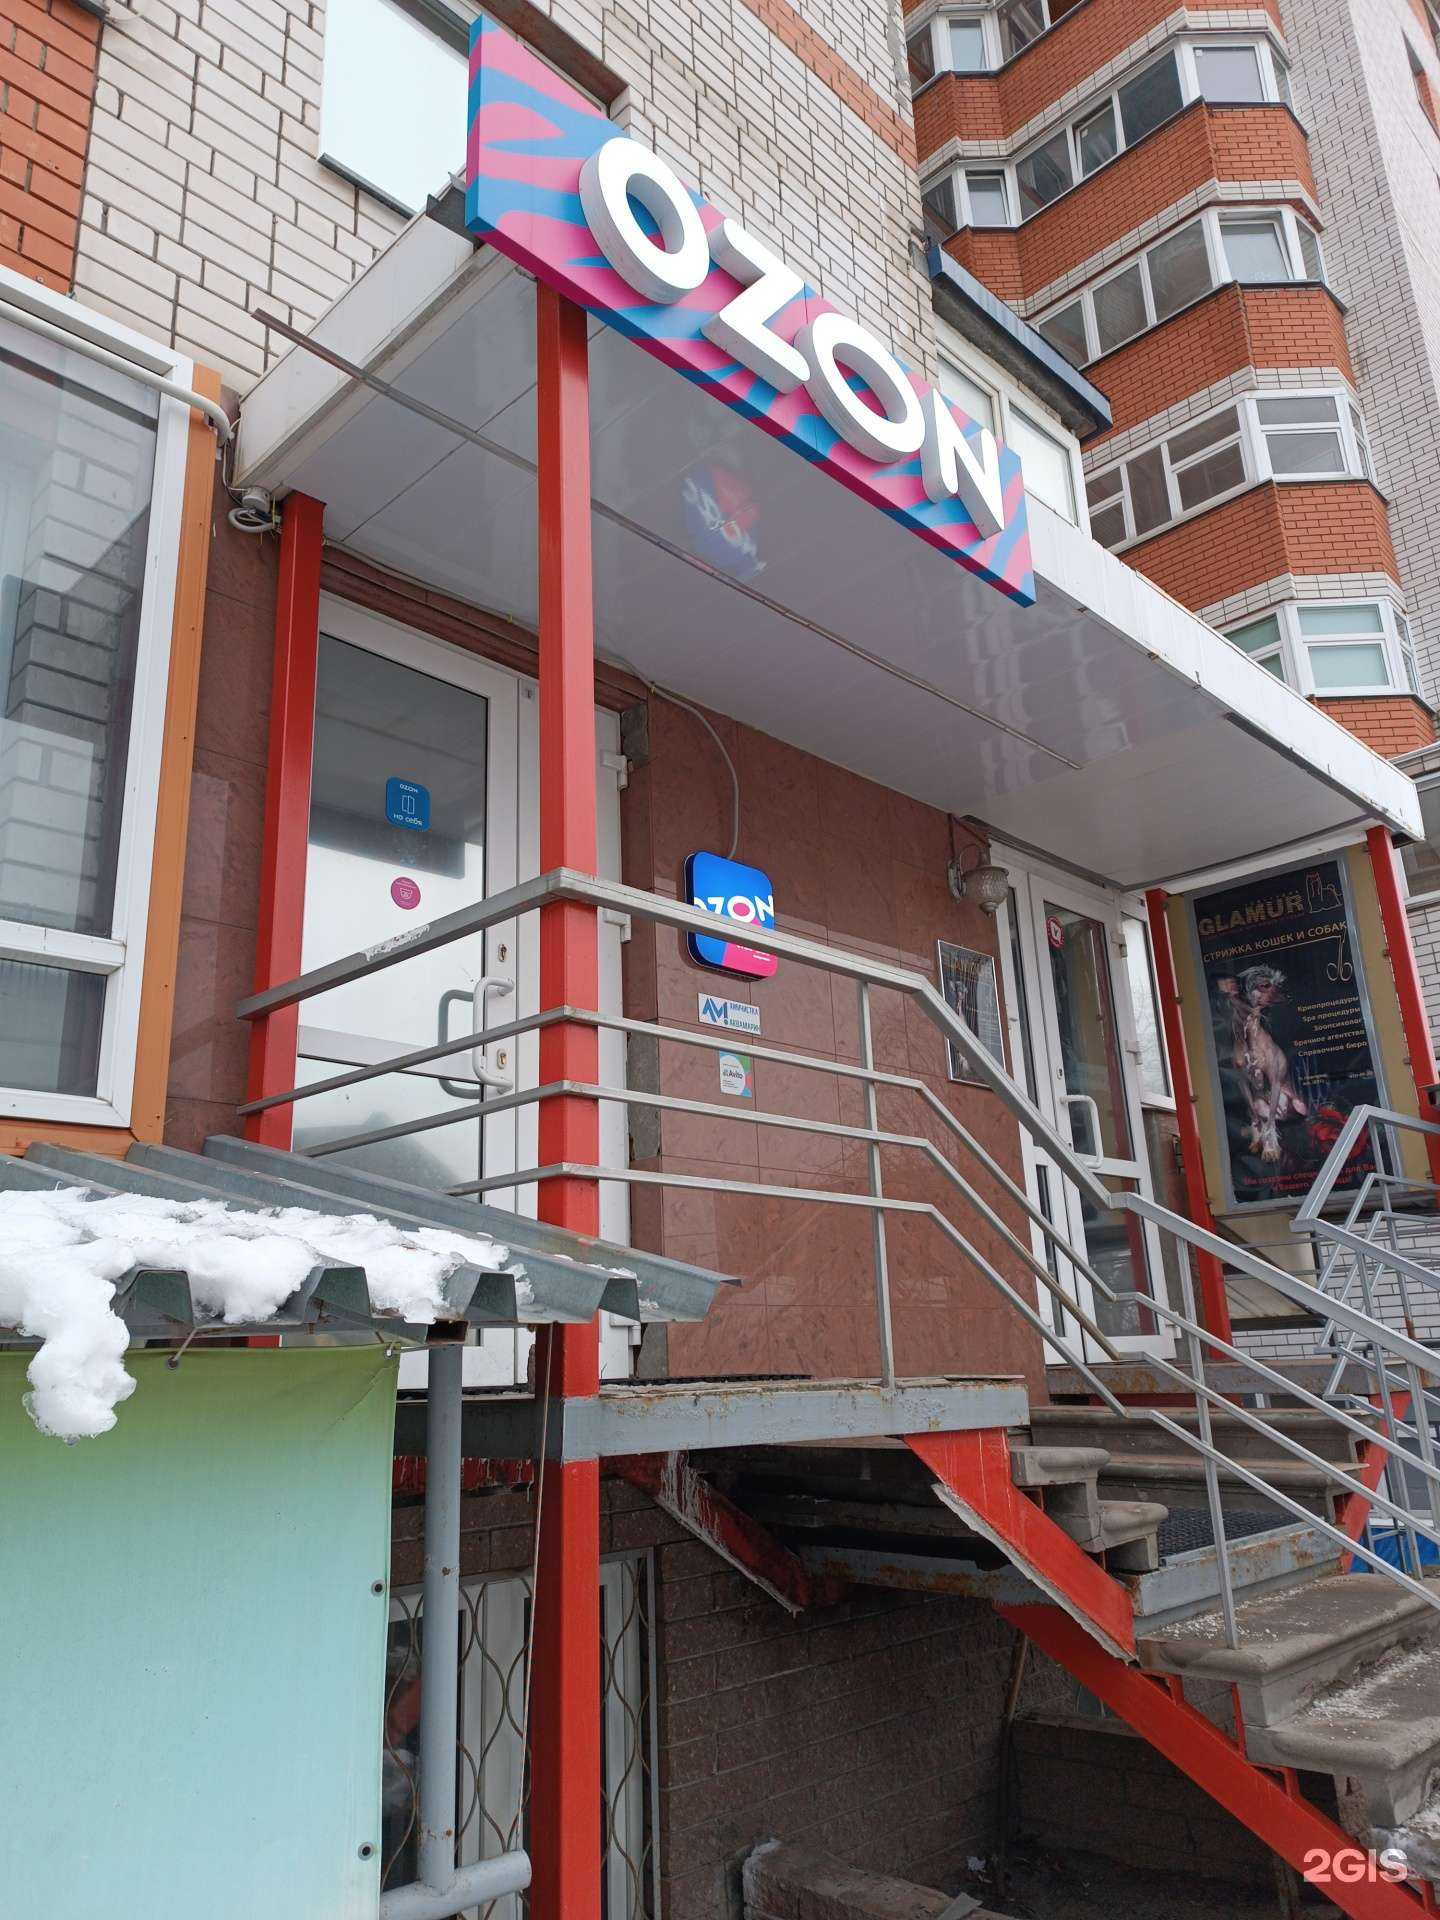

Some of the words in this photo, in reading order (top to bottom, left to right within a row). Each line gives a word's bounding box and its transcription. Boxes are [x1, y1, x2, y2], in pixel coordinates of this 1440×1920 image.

[580, 137, 1004, 539] OZON
[1199, 892, 1303, 936] GLAMUR
[1203, 944, 1252, 963] СТРИЖКА
[1255, 933, 1294, 950] КОШЕК
[1295, 930, 1306, 940] И
[1307, 921, 1348, 938] СОБАК
